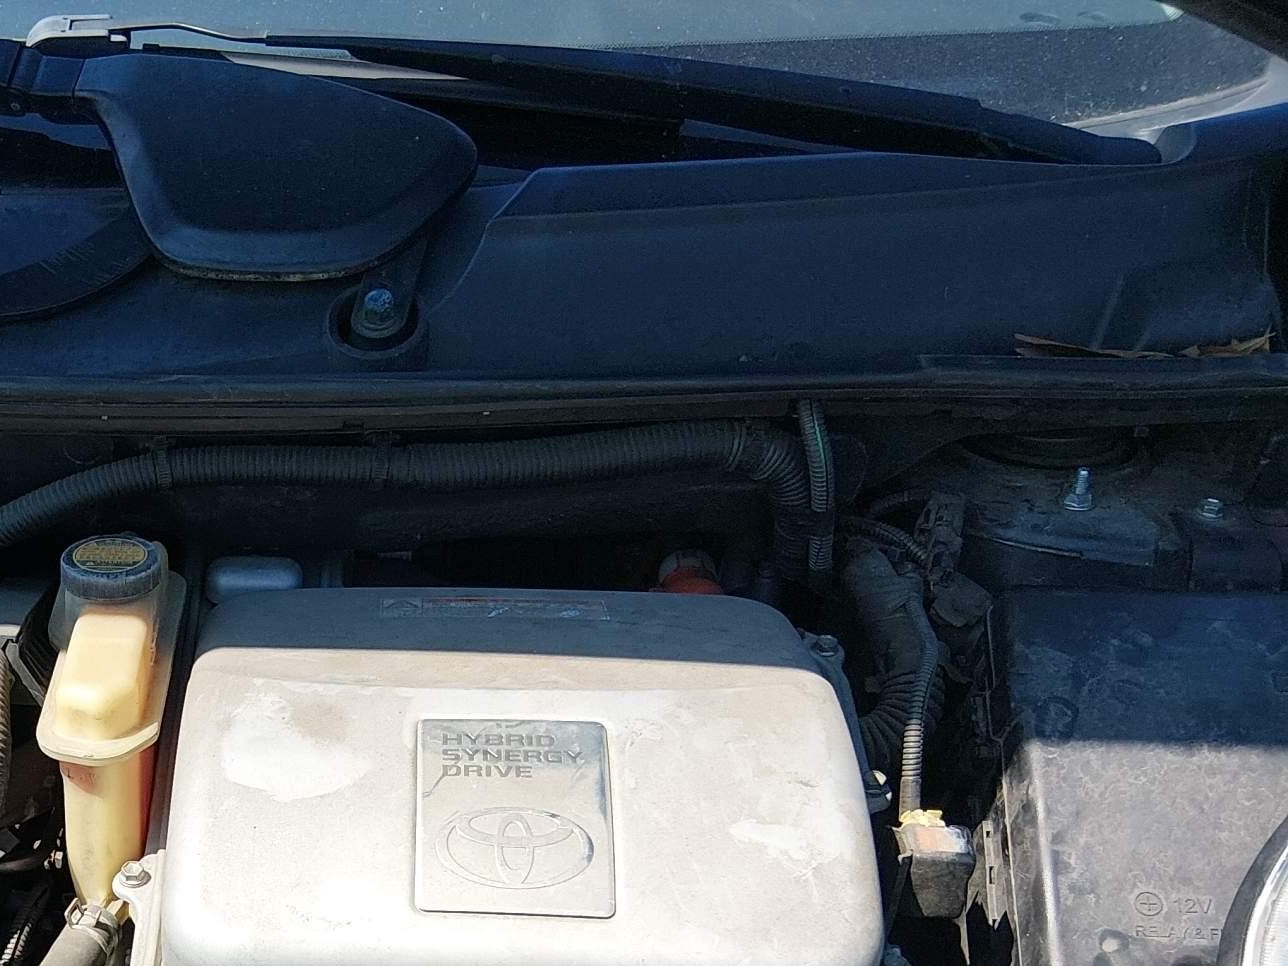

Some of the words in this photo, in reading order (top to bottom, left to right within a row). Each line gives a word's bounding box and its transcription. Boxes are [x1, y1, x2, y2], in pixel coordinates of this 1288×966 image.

[442, 733, 556, 747] HYBRID
[442, 748, 584, 764] SYNERGY
[442, 764, 533, 778] DRIVE
[1173, 898, 1212, 914] 12V
[1135, 925, 1188, 939] RELAY
